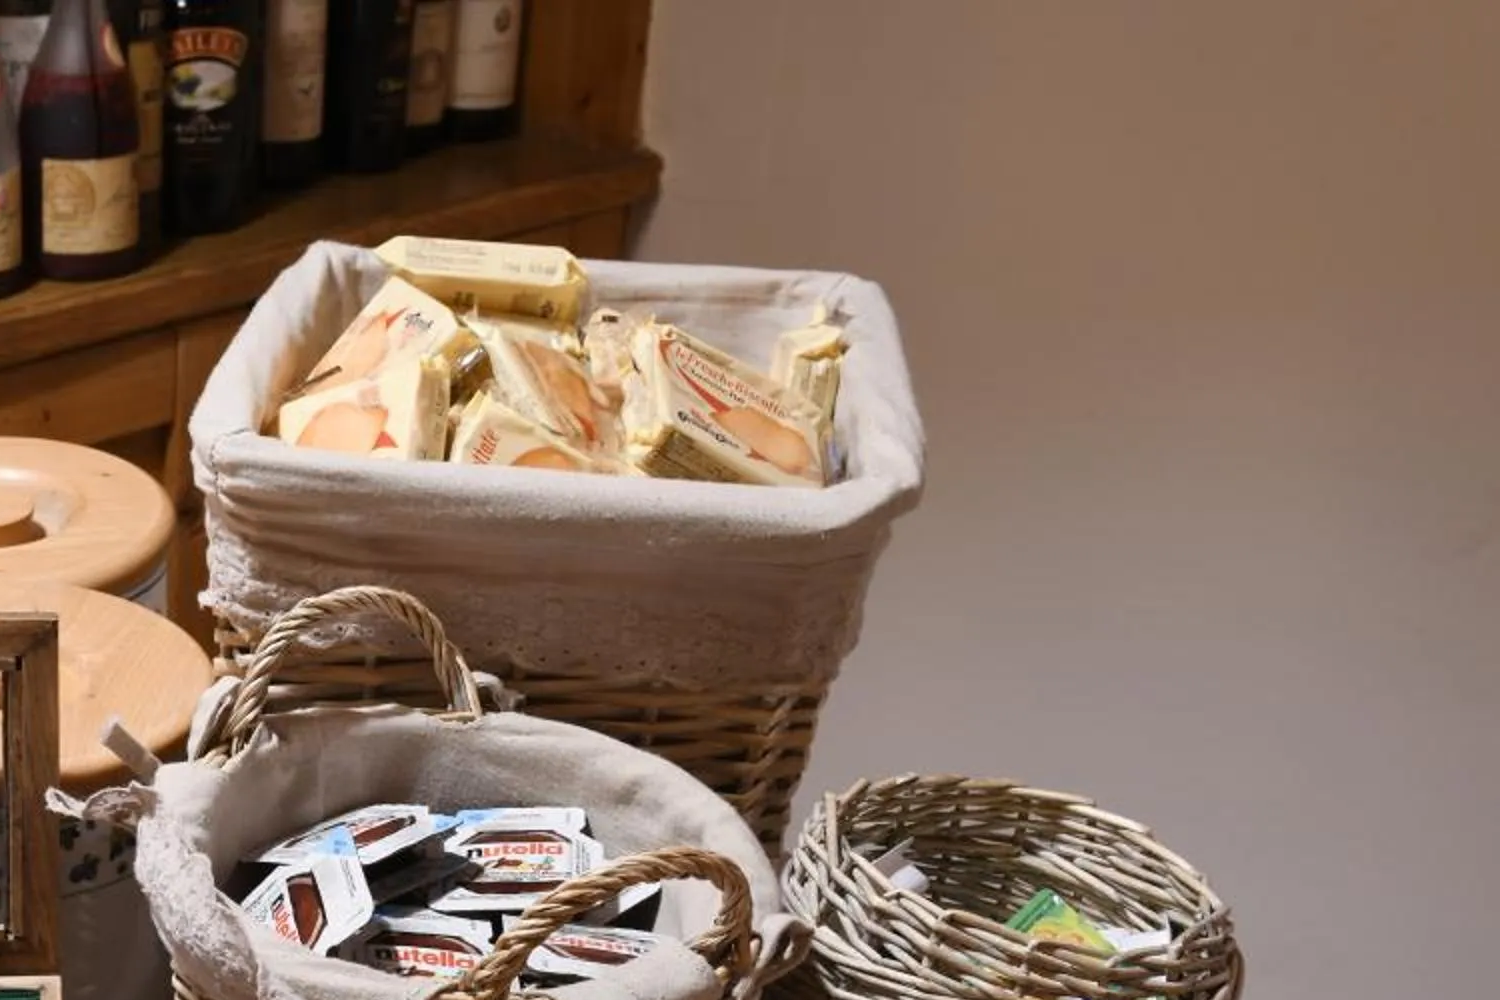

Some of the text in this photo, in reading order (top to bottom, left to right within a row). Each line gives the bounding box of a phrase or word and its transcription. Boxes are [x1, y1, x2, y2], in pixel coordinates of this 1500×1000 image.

[467, 842, 564, 860] nutella
[270, 893, 301, 944] nute
[377, 946, 475, 970] nutella
